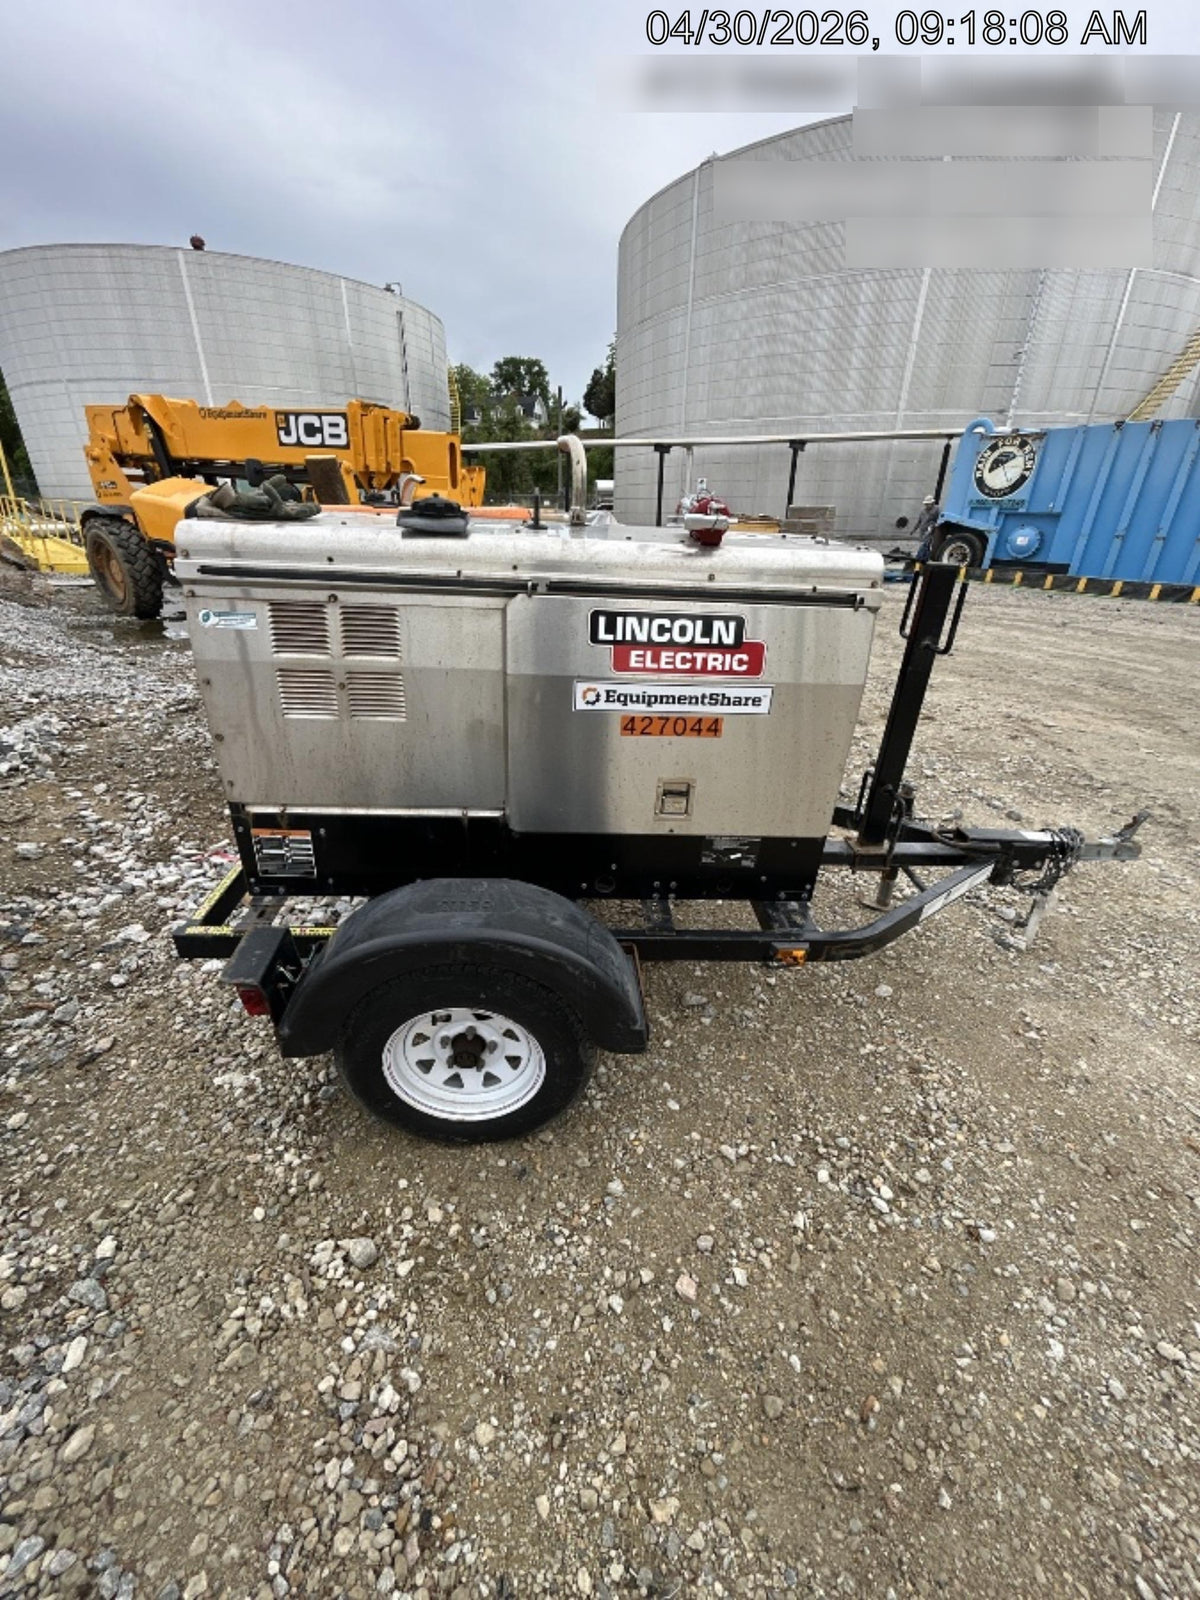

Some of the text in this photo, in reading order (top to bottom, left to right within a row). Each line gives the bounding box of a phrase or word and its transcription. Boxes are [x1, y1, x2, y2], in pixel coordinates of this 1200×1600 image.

[279, 414, 347, 446] JCB
[997, 437, 1021, 447] FOR
[597, 615, 737, 645] LINCOLN
[628, 650, 749, 672] ELECTRIC
[604, 689, 763, 708] EquipmentShare
[622, 716, 721, 737] 427044
